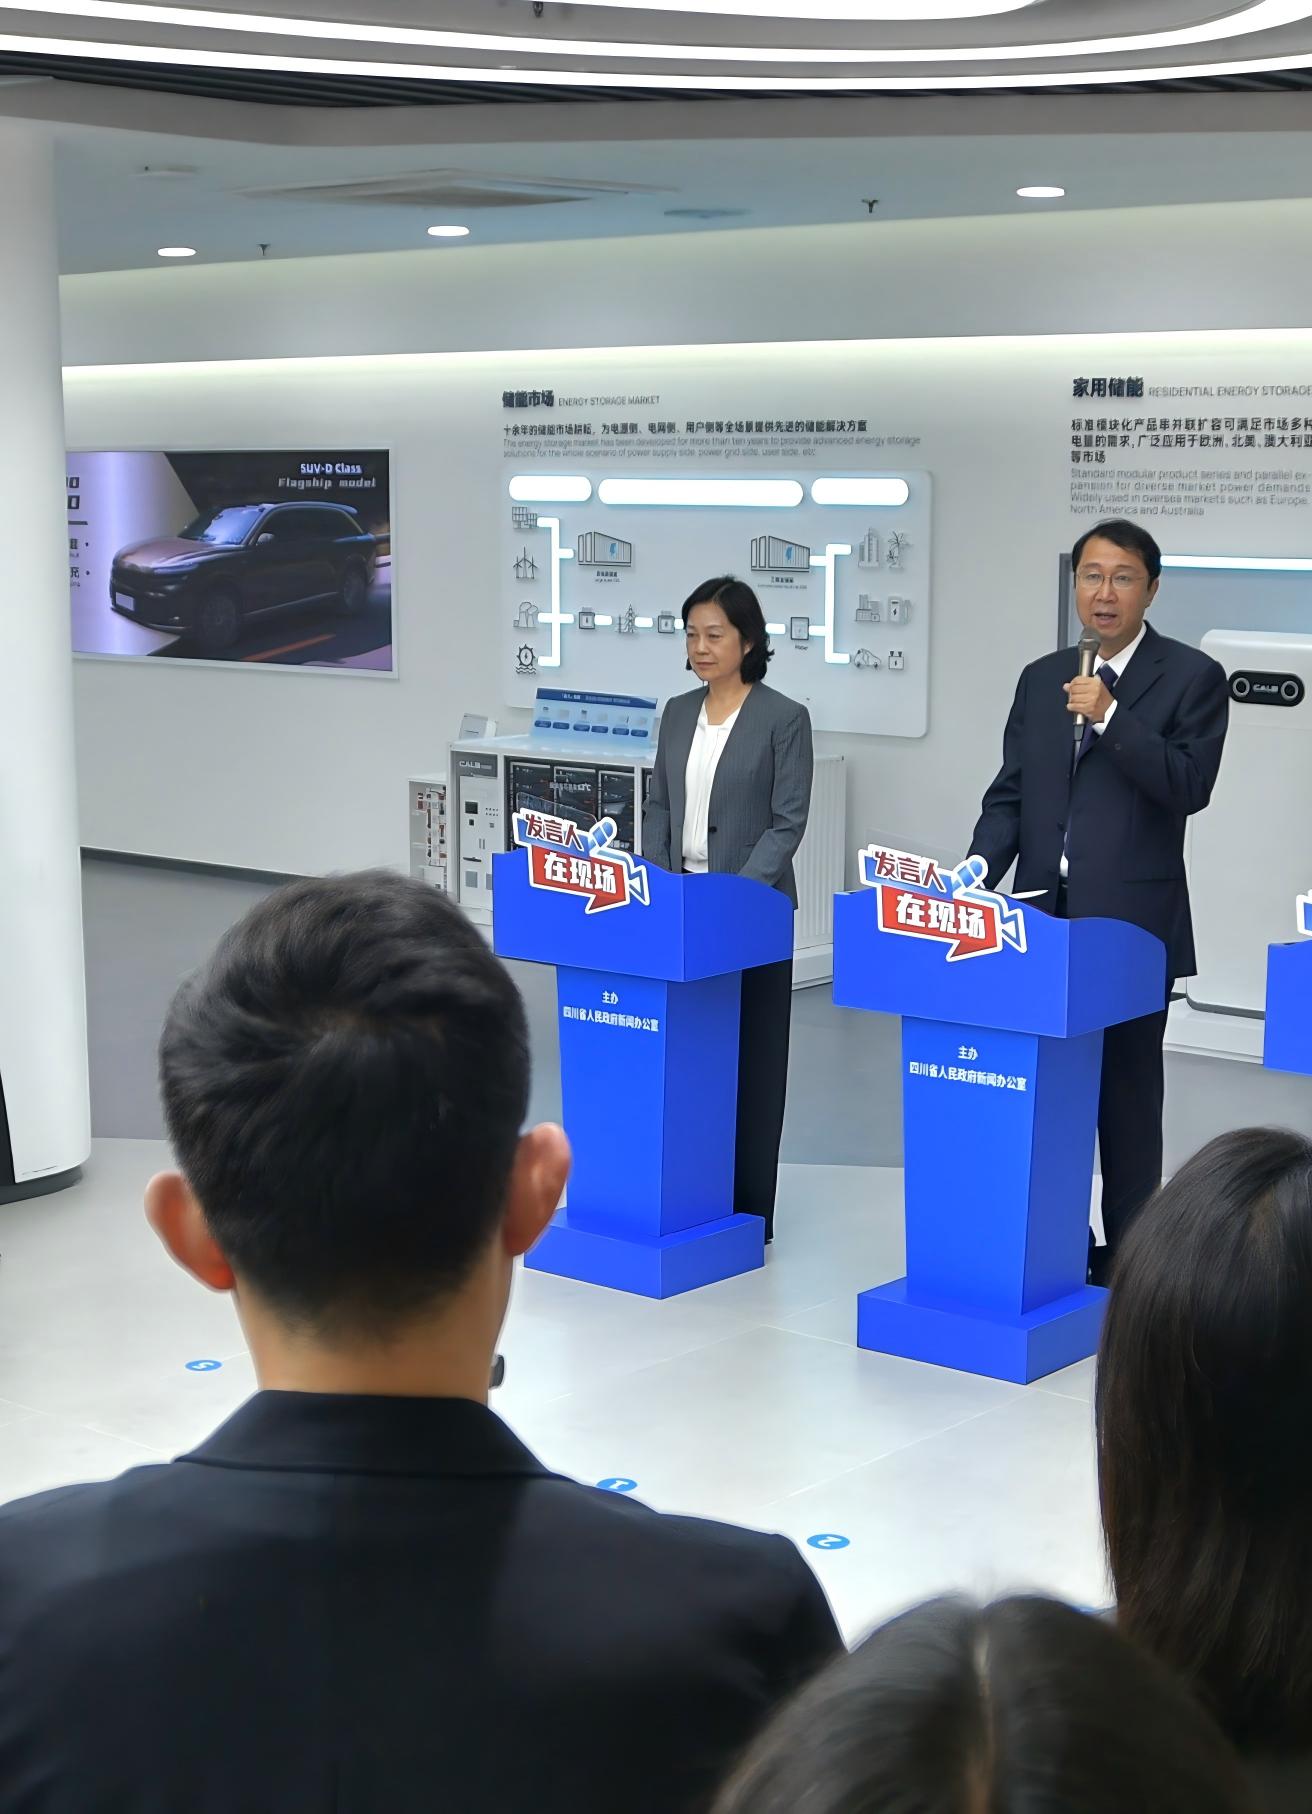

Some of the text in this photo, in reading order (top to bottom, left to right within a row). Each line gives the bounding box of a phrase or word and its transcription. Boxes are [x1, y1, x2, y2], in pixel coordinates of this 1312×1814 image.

[1072, 377, 1144, 398] 家用储能
[1149, 385, 1312, 397] RESIDENTIAL ENERGY STORAGE
[502, 389, 555, 408] 储能市场
[558, 395, 660, 408] ENERGY STORAGE MARKET
[335, 462, 362, 474] Class
[278, 477, 376, 490] Flagship model
[525, 813, 584, 851] 发言人
[543, 852, 617, 894] 在现场
[875, 850, 946, 891] 发言人
[896, 893, 986, 939] 在现场
[602, 991, 618, 1005] 主办
[563, 1006, 659, 1032] 四川省人民政府新闻办公室
[958, 1046, 978, 1060] 主办
[909, 1061, 1028, 1091] 四川省人民政府新闻办公室
